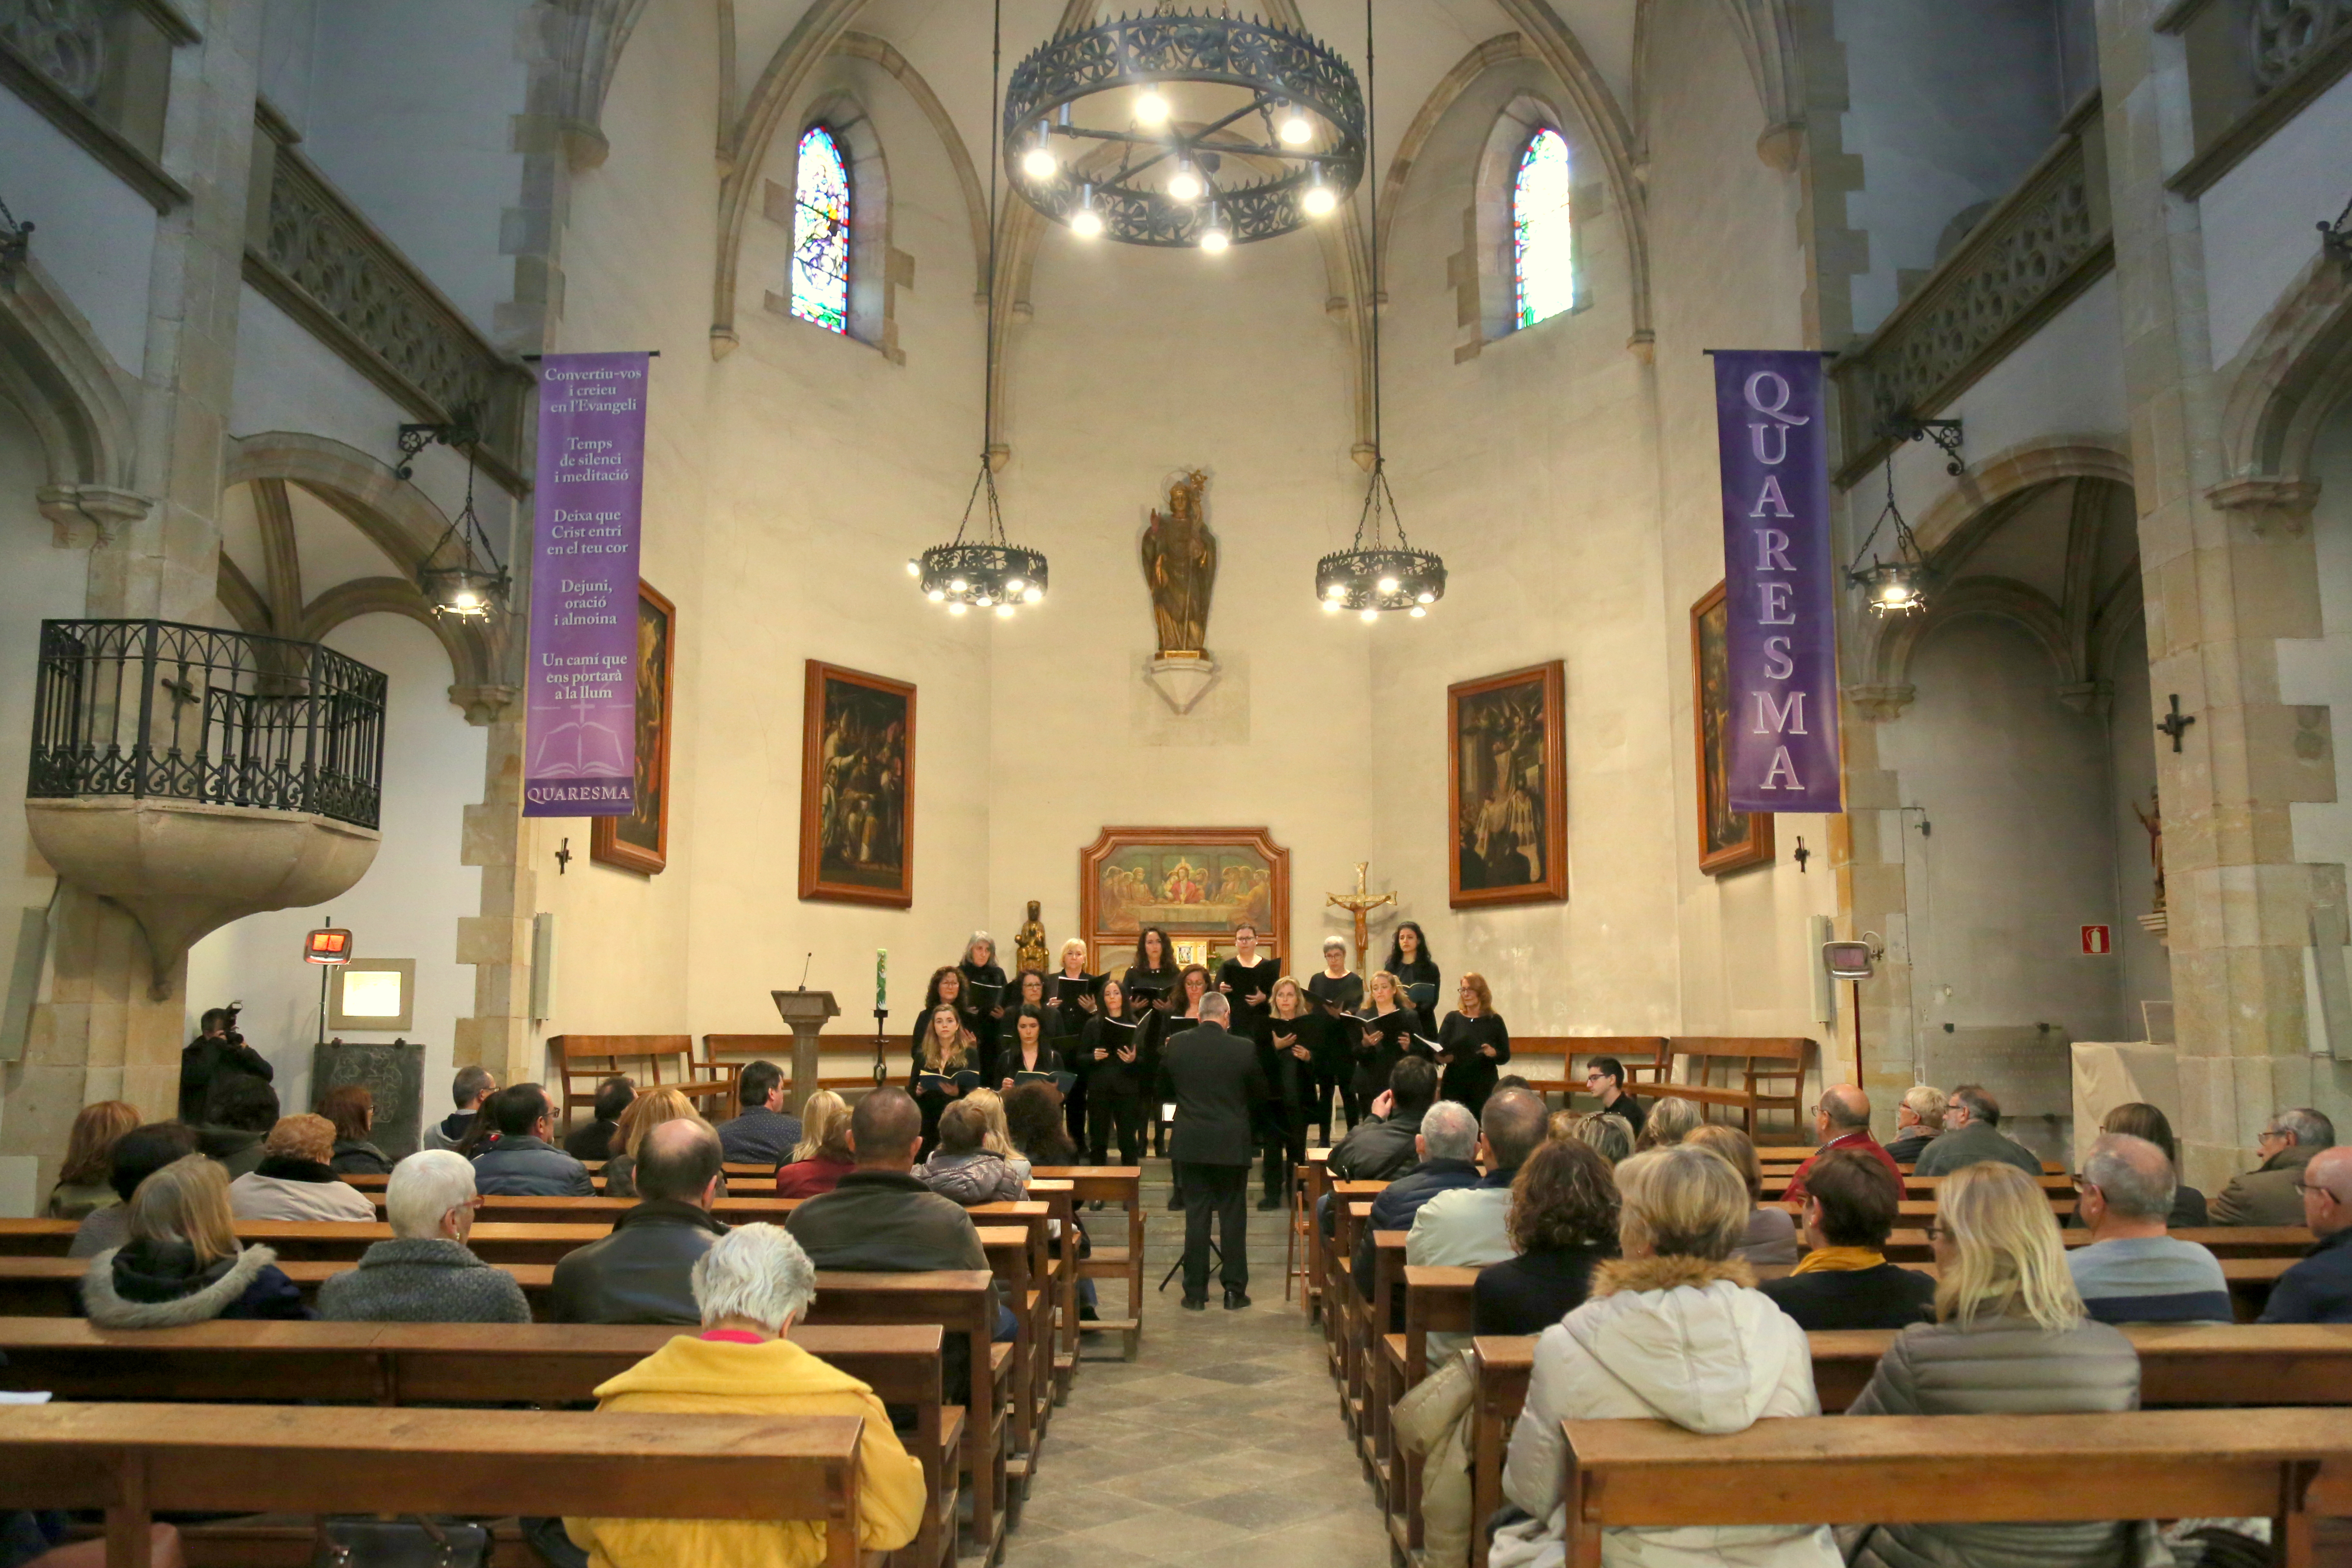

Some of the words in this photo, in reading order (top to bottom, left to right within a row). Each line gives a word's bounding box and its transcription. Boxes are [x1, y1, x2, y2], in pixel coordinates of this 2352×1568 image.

[545, 368, 642, 381] Convertiu-vos
[569, 385, 574, 396] i
[577, 384, 617, 396] creieu
[551, 403, 567, 412] en
[570, 398, 637, 414] l'Evangeli
[567, 437, 613, 453] Temps
[560, 453, 575, 467] de
[578, 452, 621, 466] silenci
[554, 471, 559, 483] i
[562, 468, 629, 483] meditació
[553, 509, 592, 522] Deixa
[595, 511, 621, 525] que
[552, 525, 586, 539] Crist
[588, 525, 622, 537] entri
[547, 546, 564, 555] en
[566, 541, 578, 554] el
[581, 544, 603, 553] teu
[606, 544, 629, 553] cor
[561, 579, 612, 596] Dejuni,
[1744, 370, 1809, 790] QUARESMA
[565, 596, 607, 609] oració
[554, 614, 558, 626] i
[562, 612, 617, 626] almoina
[542, 653, 563, 666] Un
[566, 653, 599, 666] camí
[602, 655, 628, 669] que
[546, 673, 569, 683] ens
[572, 669, 623, 687] portarà
[555, 690, 563, 699] a
[565, 686, 577, 699] la
[580, 685, 613, 699] llum
[527, 786, 630, 804] QUARESMA
